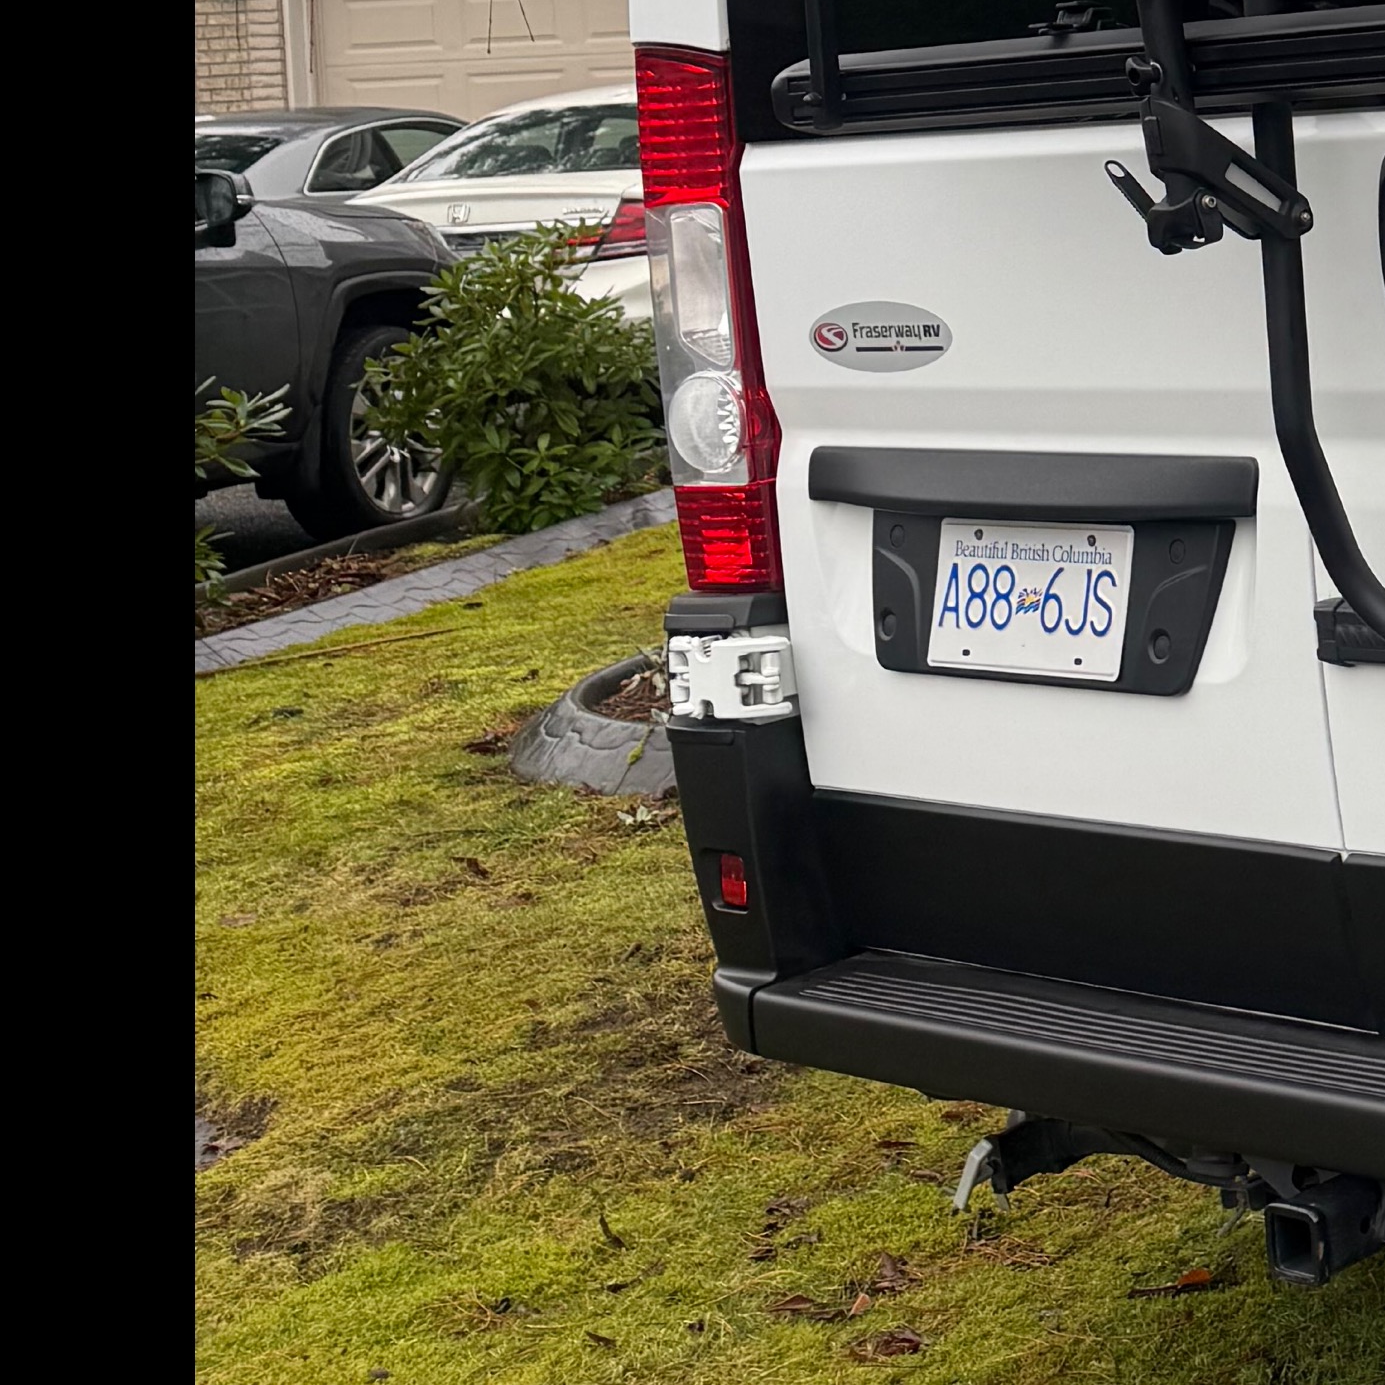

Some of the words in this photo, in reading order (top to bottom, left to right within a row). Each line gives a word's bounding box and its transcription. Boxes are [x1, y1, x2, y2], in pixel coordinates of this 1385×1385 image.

[851, 322, 922, 342] Fraserway
[955, 540, 1008, 559] Beautiful
[1011, 543, 1049, 562] British
[1052, 544, 1112, 565] Columbia
[938, 562, 1016, 631] A88
[1040, 567, 1118, 638] 6JS
